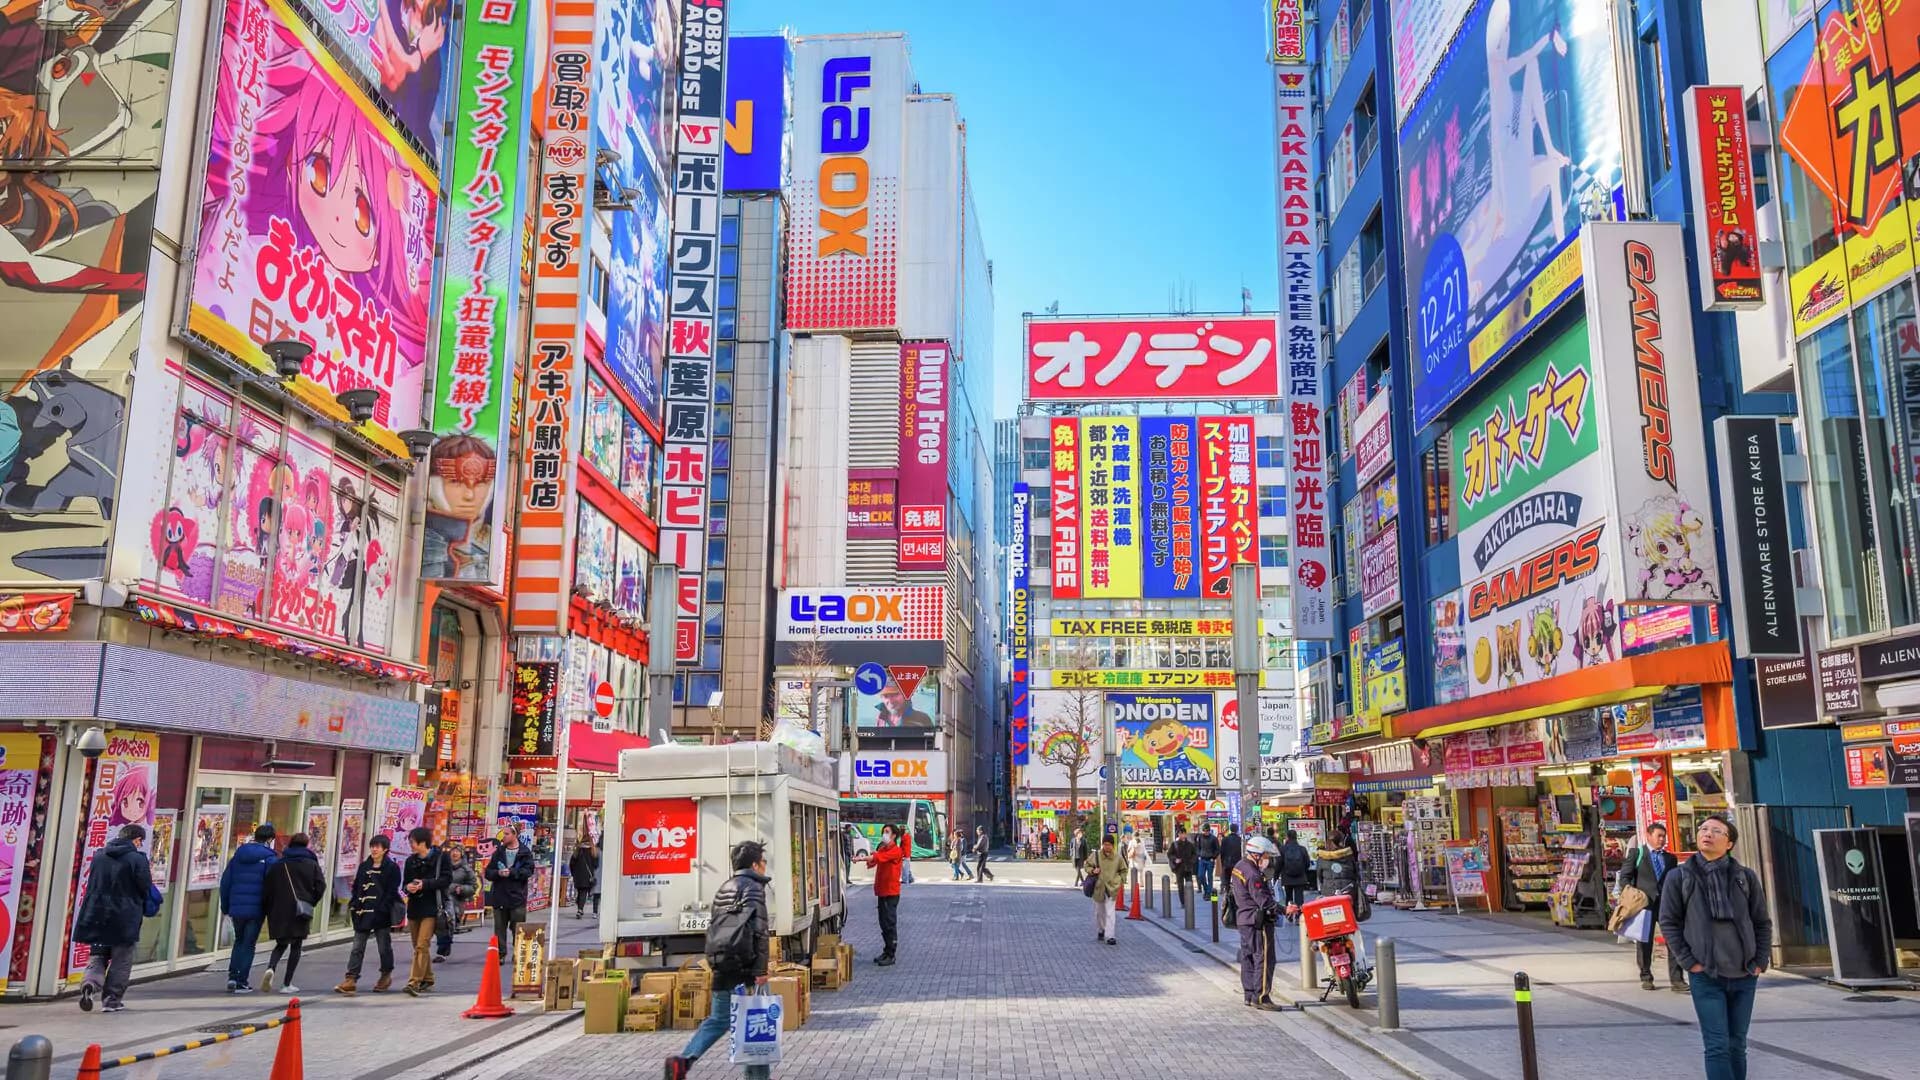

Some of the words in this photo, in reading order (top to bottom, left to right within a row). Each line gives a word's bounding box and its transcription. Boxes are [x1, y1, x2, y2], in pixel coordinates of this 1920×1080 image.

[681, 0, 702, 111] ARADISE
[554, 53, 589, 132] 買取り
[1279, 106, 1311, 246] TAKARADA
[1711, 109, 1739, 225] カードキングダム
[546, 173, 578, 270] まっくす
[1421, 267, 1462, 348] 12.21
[903, 350, 918, 399] Flagship
[1033, 321, 1272, 388] オノデン
[1288, 325, 1317, 396] 免税商店
[1426, 349, 1440, 375] ON
[1442, 323, 1463, 360] SALE
[1624, 239, 1678, 493] GAMERS
[916, 349, 945, 406] Duty
[531, 343, 569, 508] アキバ駅前店
[904, 404, 917, 438] Store
[917, 410, 945, 464] Free
[1054, 425, 1075, 472] 免税
[1746, 433, 1764, 482] AKIBA
[1055, 476, 1075, 520] TAX
[1150, 436, 1169, 568] お見積り無料です
[1291, 402, 1325, 550] 歓迎光臨
[904, 510, 941, 527] 免税
[1011, 493, 1028, 578] Panasonic
[1482, 495, 1569, 558] AKIHABARA
[1754, 486, 1770, 538] STORE
[903, 542, 941, 556] 면세점
[1055, 526, 1077, 588] FREE
[1469, 525, 1604, 620] GAMERS
[1758, 541, 1779, 638] ALIENWARE
[788, 625, 816, 635] Home
[819, 625, 873, 635] Electronics
[876, 625, 903, 635] Store
[1014, 588, 1028, 660] ONODEN
[1060, 621, 1097, 634] TAX
[1101, 621, 1147, 634] FREE
[1151, 620, 1192, 634] 免税店
[896, 671, 920, 681] 止まれ
[1061, 672, 1098, 685] テレビ
[1103, 672, 1142, 685] 冷蔵庫
[1148, 672, 1199, 685] エアコン
[1765, 658, 1806, 674] ALIENWARE
[1766, 676, 1787, 687] STORE
[1788, 673, 1808, 684] AKIBA
[1262, 701, 1292, 711] Japan.
[1272, 722, 1294, 731] Shop
[1116, 767, 1211, 782] KIHABARA
[1125, 800, 1199, 811] オノデン
